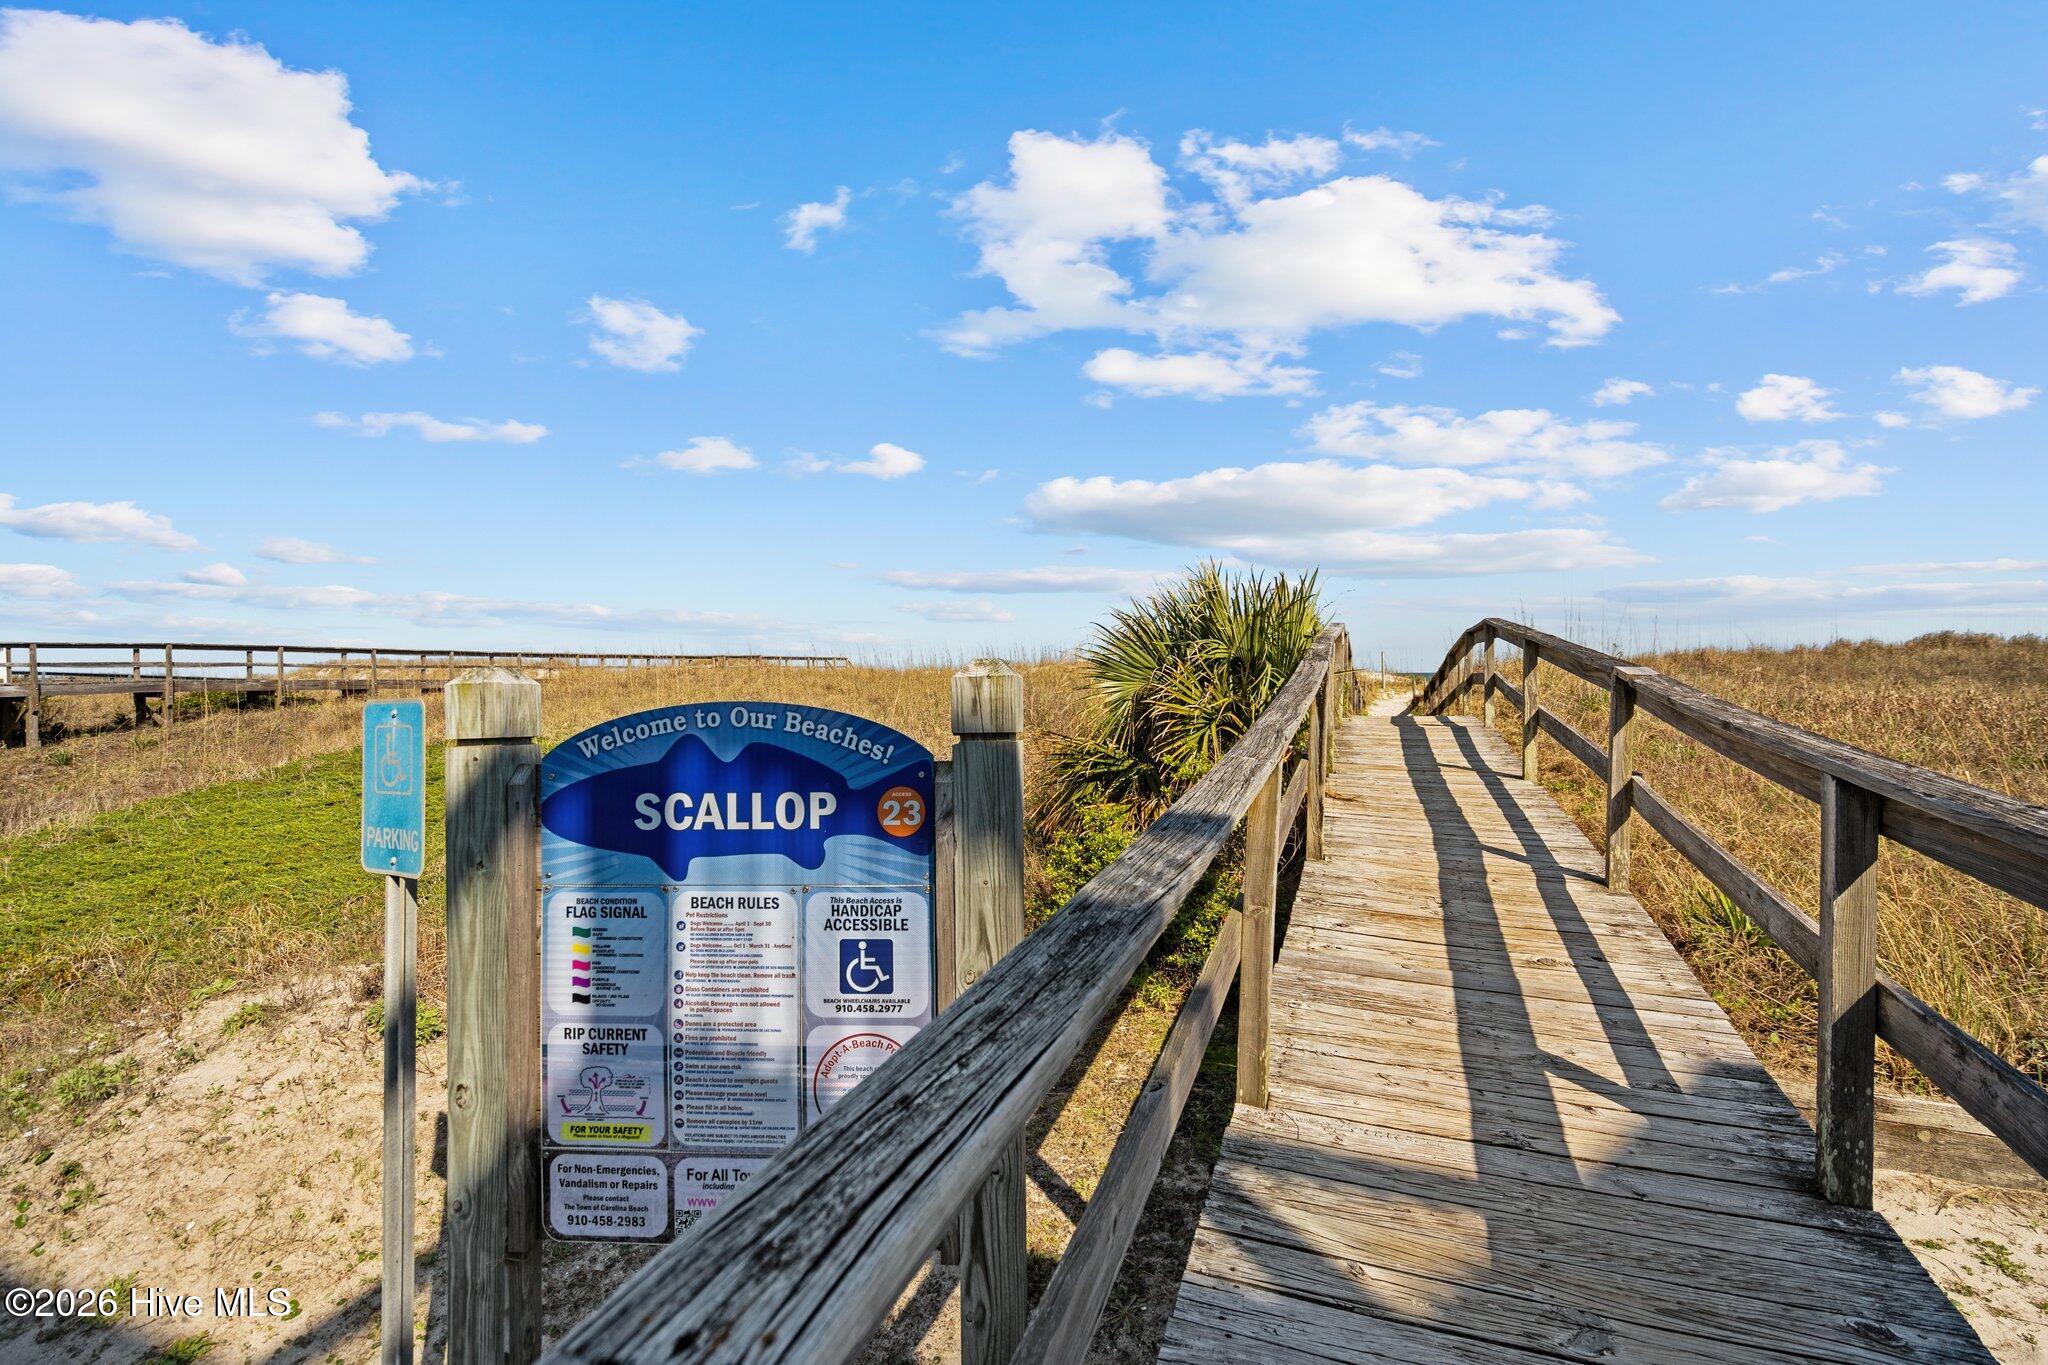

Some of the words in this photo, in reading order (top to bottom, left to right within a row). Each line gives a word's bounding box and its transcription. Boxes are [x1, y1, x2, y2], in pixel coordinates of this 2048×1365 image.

[577, 715, 687, 758] Welcome
[695, 709, 720, 728] to
[730, 707, 777, 729] Our
[783, 712, 894, 764] Beaches!
[634, 791, 837, 830] SCALLOP
[883, 800, 920, 825] 23
[367, 826, 419, 852] PARKING
[691, 897, 733, 909] BEACH
[738, 897, 779, 909] RULES
[566, 906, 596, 918] FLAG
[601, 906, 647, 918] SIGNAL
[831, 905, 902, 917] HANDICAP
[824, 919, 908, 931] ACCESSIBLE
[564, 1028, 585, 1039] RIP
[589, 1028, 647, 1040] CURRENT
[583, 1043, 628, 1055] SAFETY
[821, 1039, 883, 1078] Adopt-A-Beach
[589, 1126, 610, 1134] YOUR
[558, 1164, 572, 1173] For
[574, 1164, 660, 1177] Non-Emergencies,
[687, 1168, 708, 1180] For
[711, 1169, 727, 1181] All
[559, 1179, 607, 1188] Vandalism
[622, 1180, 658, 1191] Repairs
[703, 1183, 735, 1191] including
[567, 1215, 646, 1227] 910-458-2983
